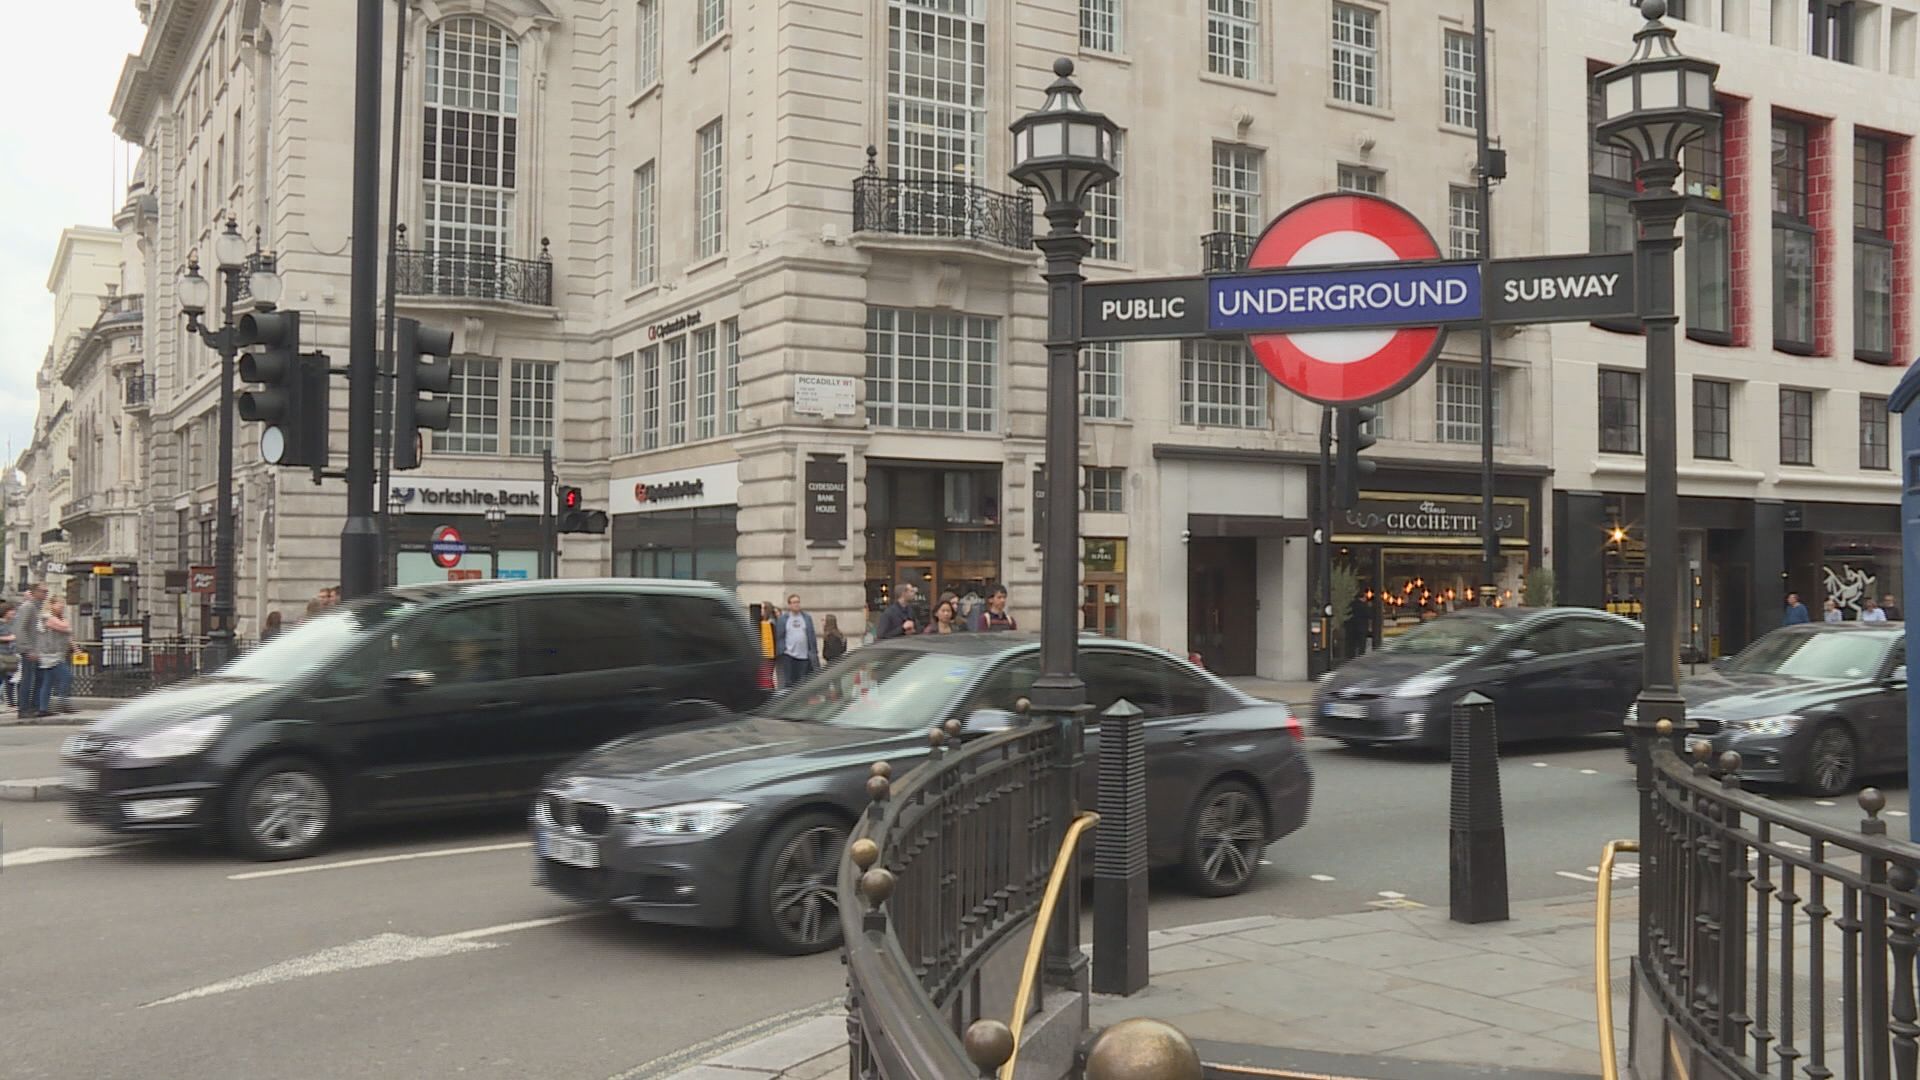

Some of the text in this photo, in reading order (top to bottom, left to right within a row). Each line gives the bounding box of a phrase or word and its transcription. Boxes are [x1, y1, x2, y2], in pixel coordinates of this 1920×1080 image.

[1101, 273, 1619, 321] PUBLIC UNDERGROUND SUBWAY
[798, 377, 841, 386] PICCADILLY
[808, 482, 845, 491] CLYDESDALE
[418, 488, 540, 506] Yorkshire Bank
[817, 494, 834, 502] BANK
[815, 505, 837, 513] HOUSE
[1387, 513, 1476, 530] CICCHETTI
